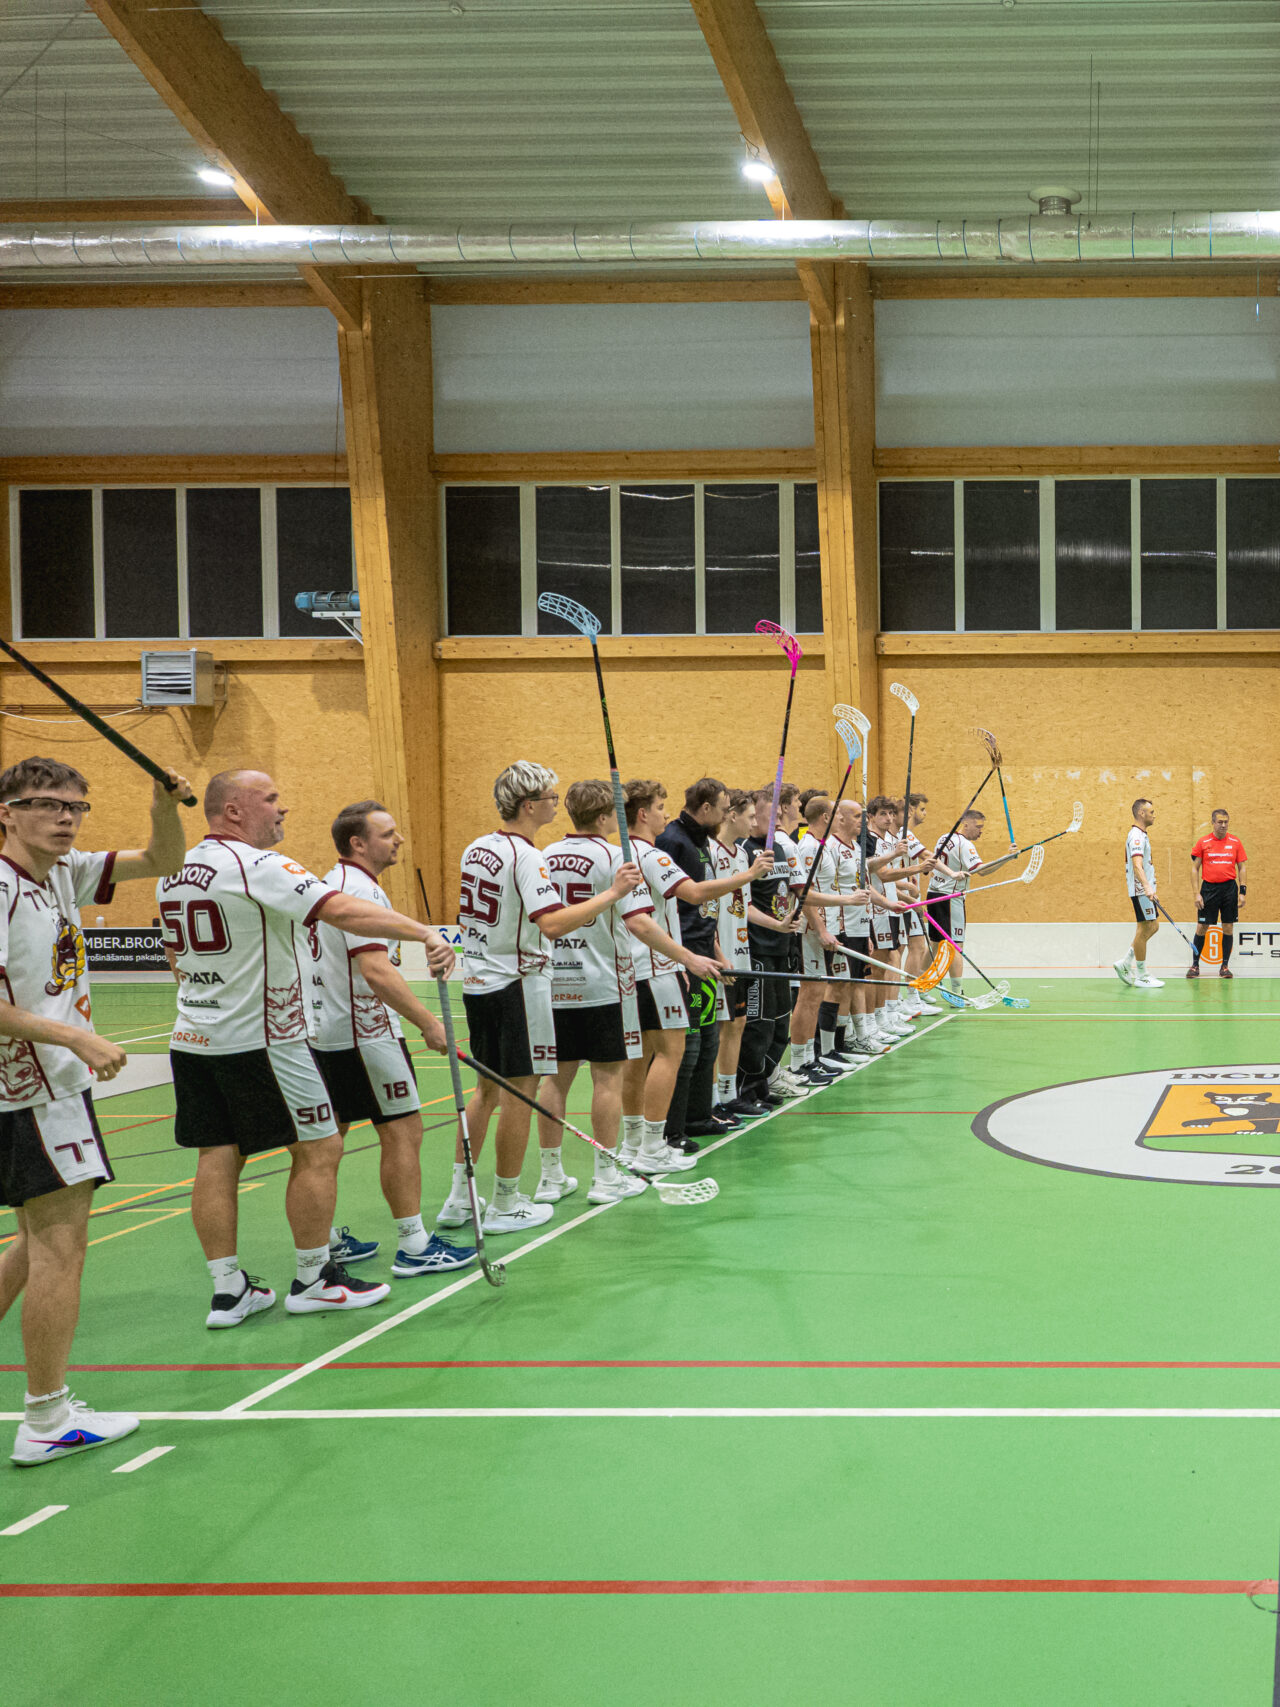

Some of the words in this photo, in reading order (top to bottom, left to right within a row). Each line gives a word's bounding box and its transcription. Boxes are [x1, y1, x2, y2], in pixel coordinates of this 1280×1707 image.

[160, 899, 231, 955] 50
[554, 939, 587, 949] PATA
[664, 1006, 681, 1018] 14
[533, 1045, 557, 1060] 55
[383, 1081, 410, 1100] 18
[296, 1102, 331, 1125] 50
